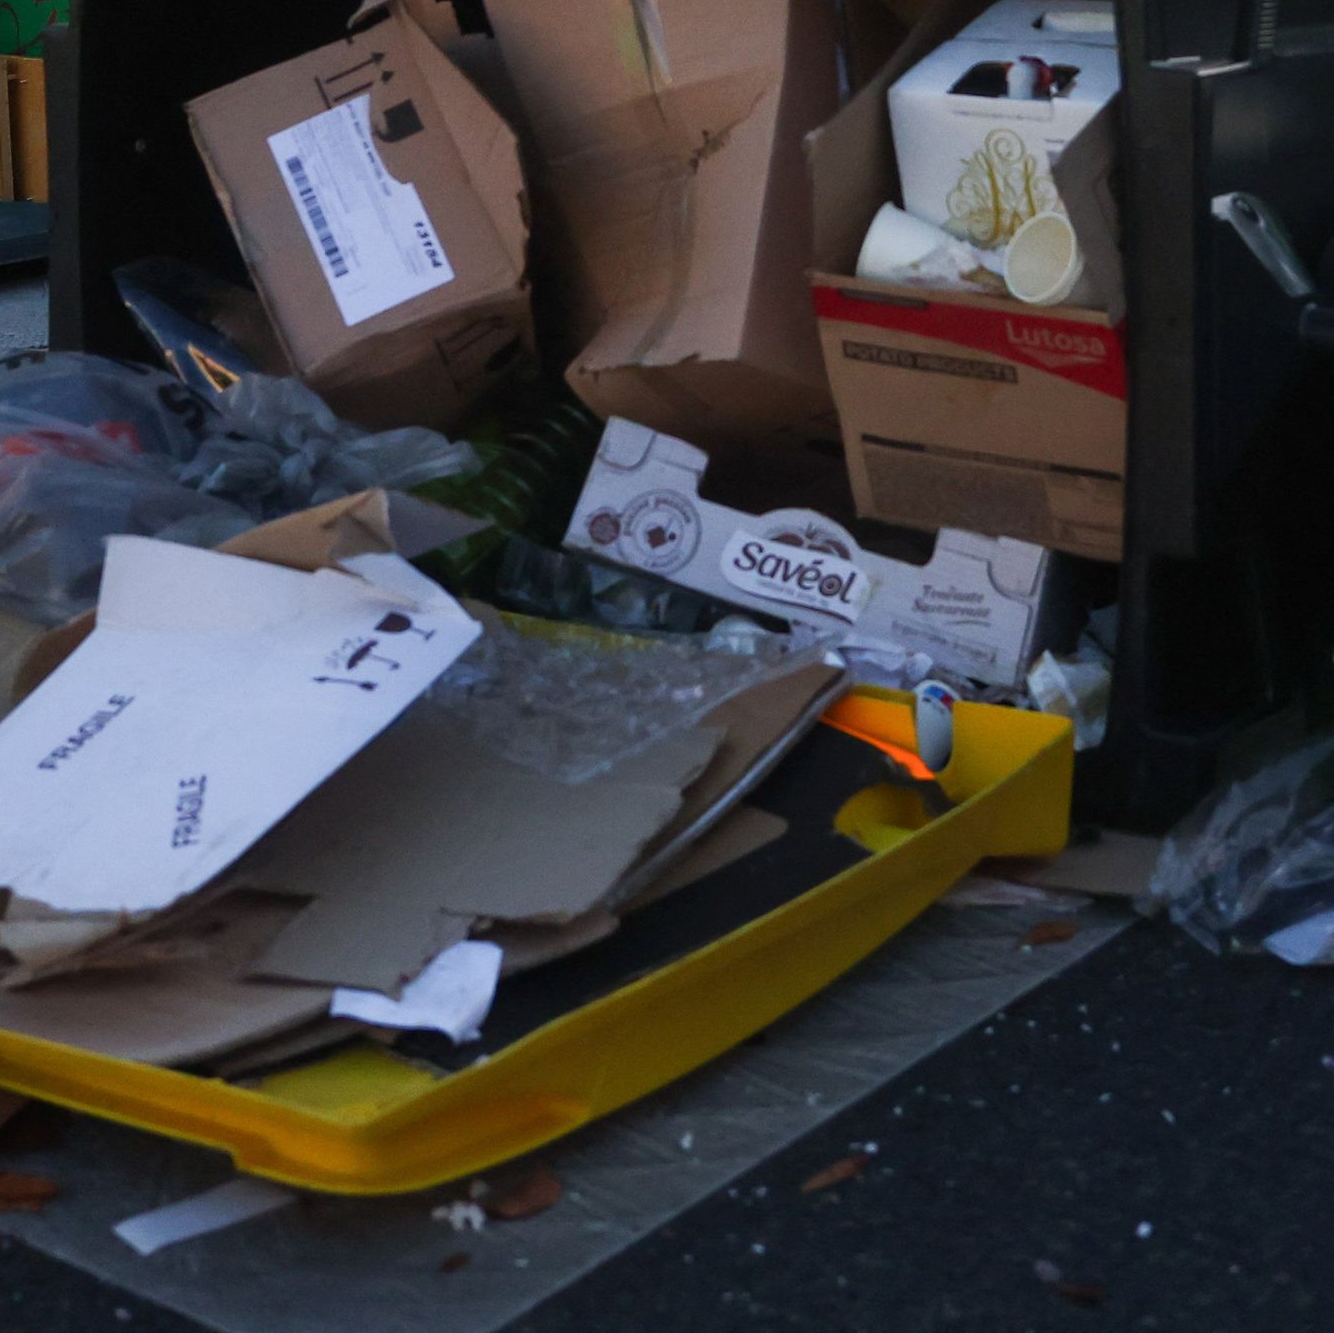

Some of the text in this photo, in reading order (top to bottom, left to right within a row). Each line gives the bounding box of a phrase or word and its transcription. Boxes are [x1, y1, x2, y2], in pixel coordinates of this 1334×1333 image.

[1006, 319, 1106, 355] Lutosa
[734, 542, 858, 604] Savéol
[37, 694, 135, 770] FRAGILE
[171, 774, 207, 849] FRAGILE
